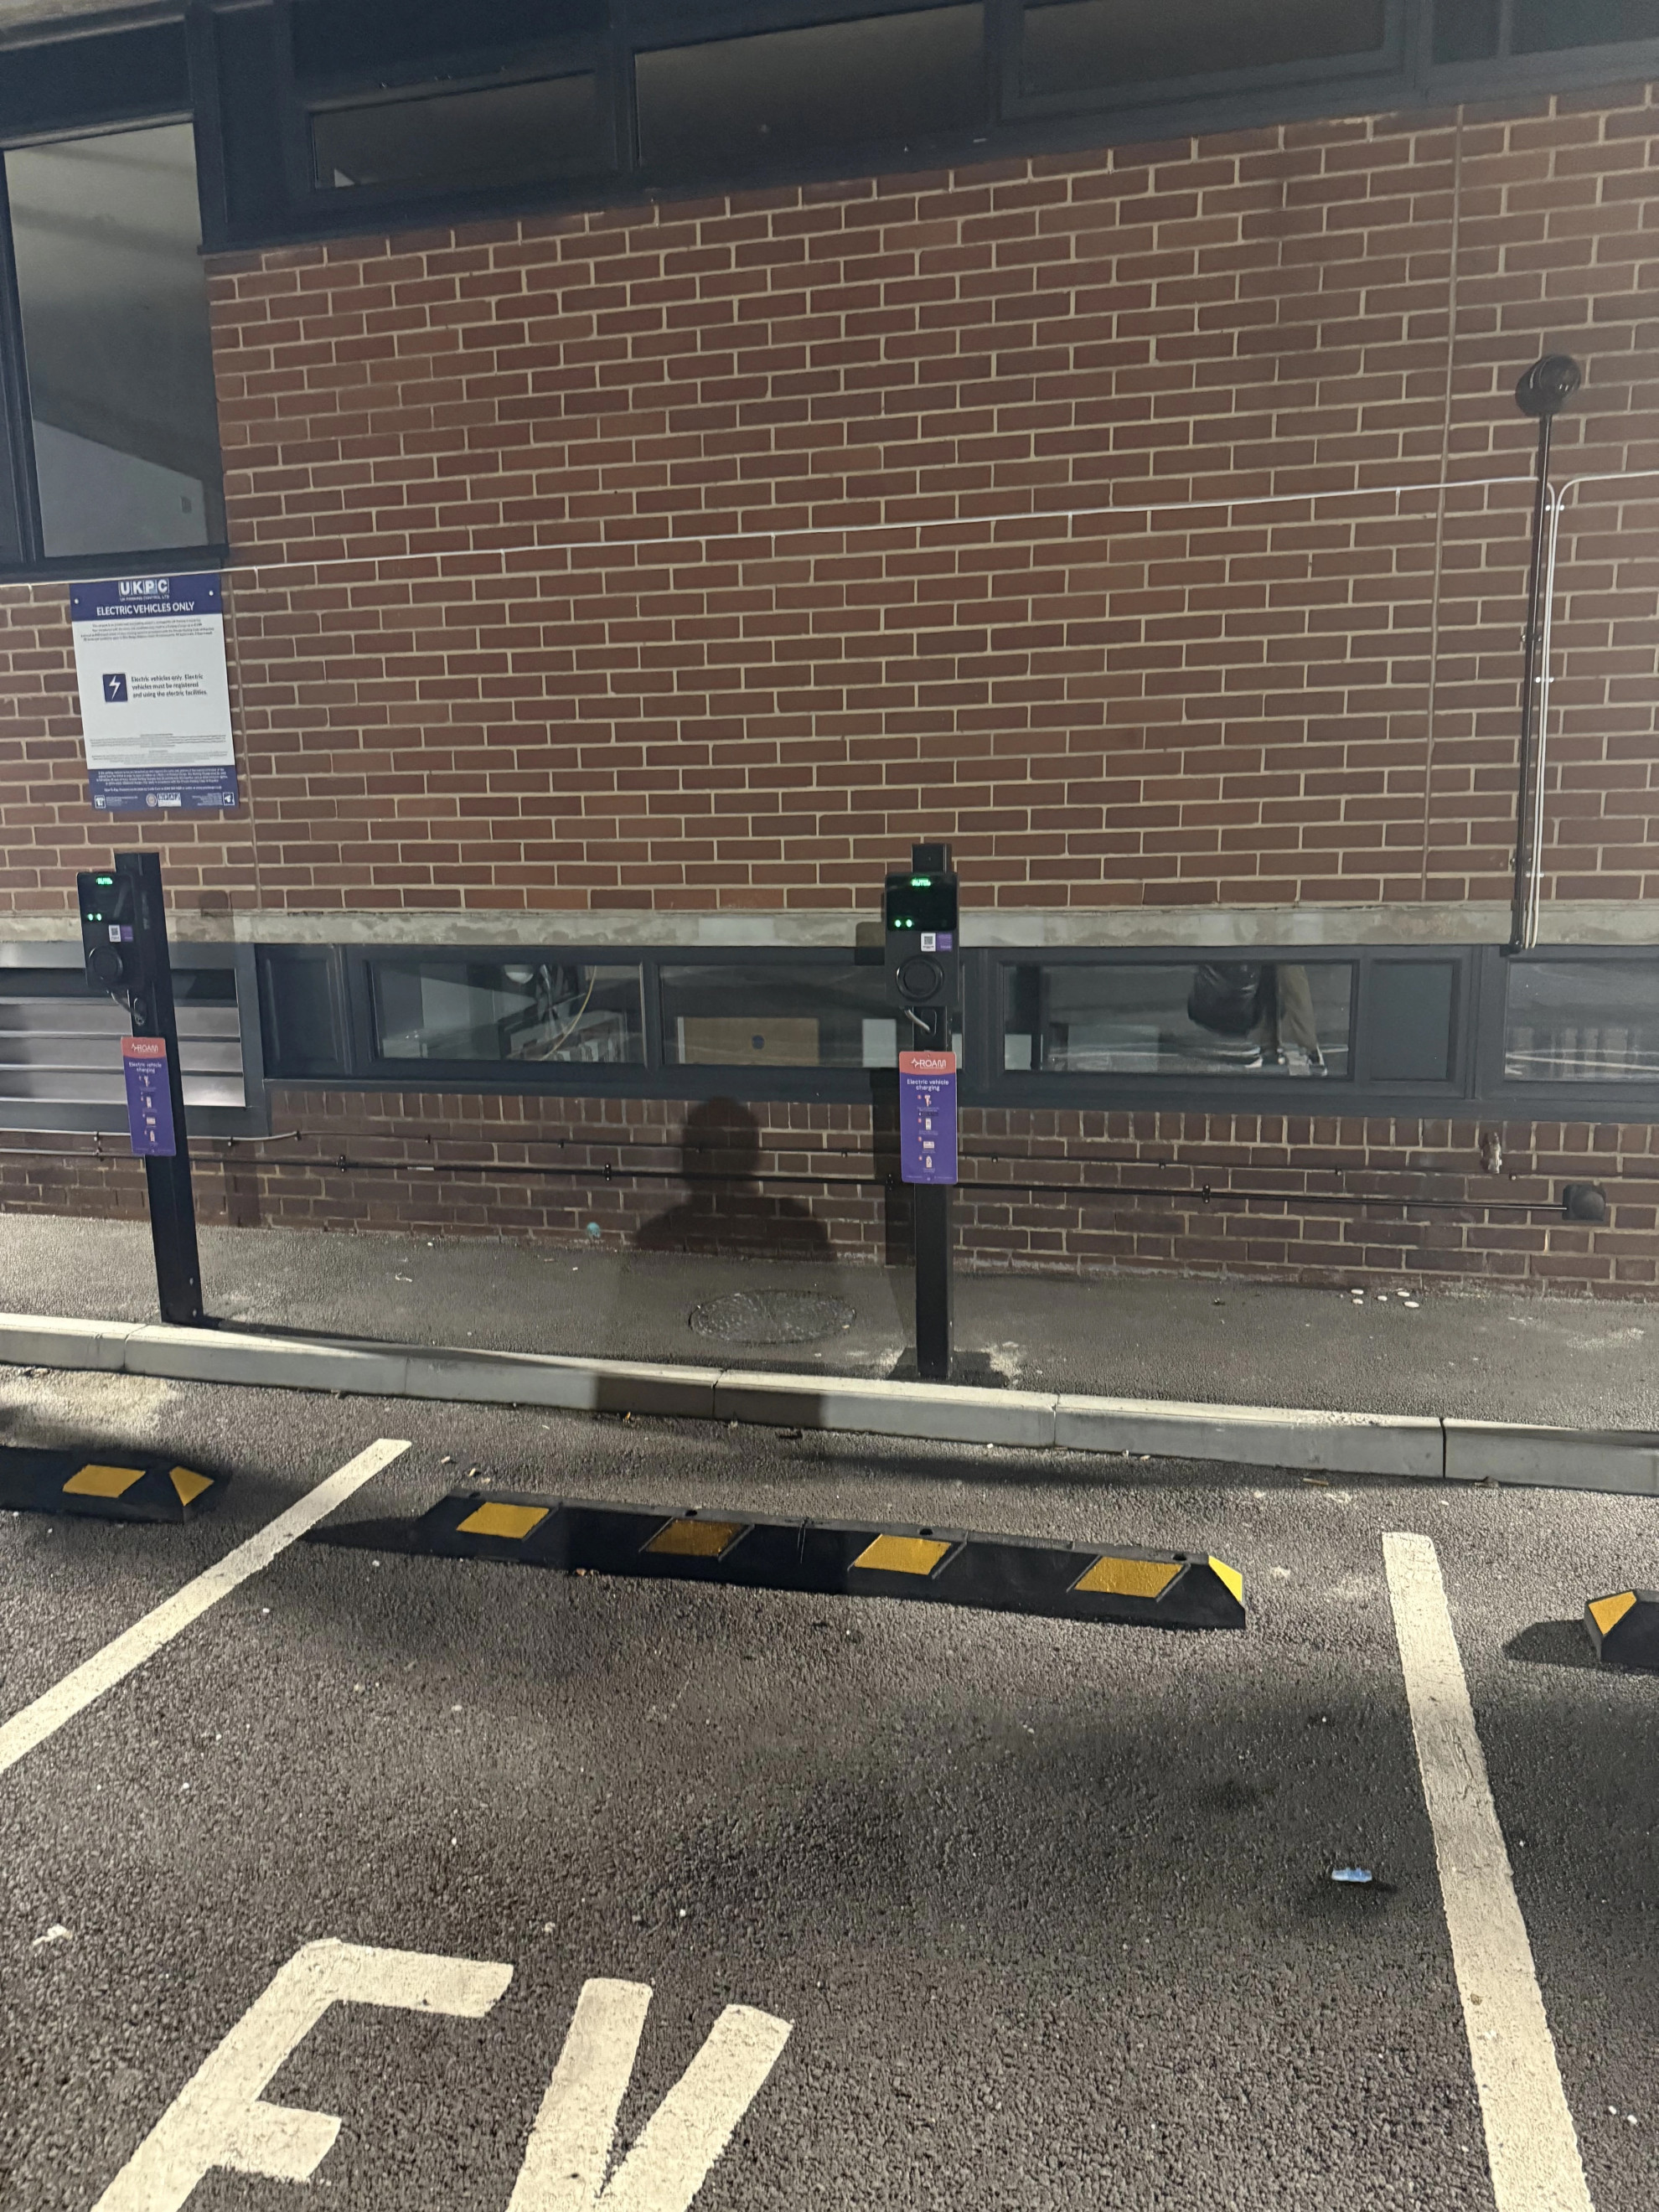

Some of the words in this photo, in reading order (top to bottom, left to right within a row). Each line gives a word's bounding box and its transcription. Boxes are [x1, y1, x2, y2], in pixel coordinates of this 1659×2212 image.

[119, 578, 169, 596] UKPC
[96, 604, 132, 616] ELECTRIC
[133, 602, 171, 614] VEHICLES
[173, 601, 195, 612] ONLY
[919, 1059, 947, 1068] ROAM
